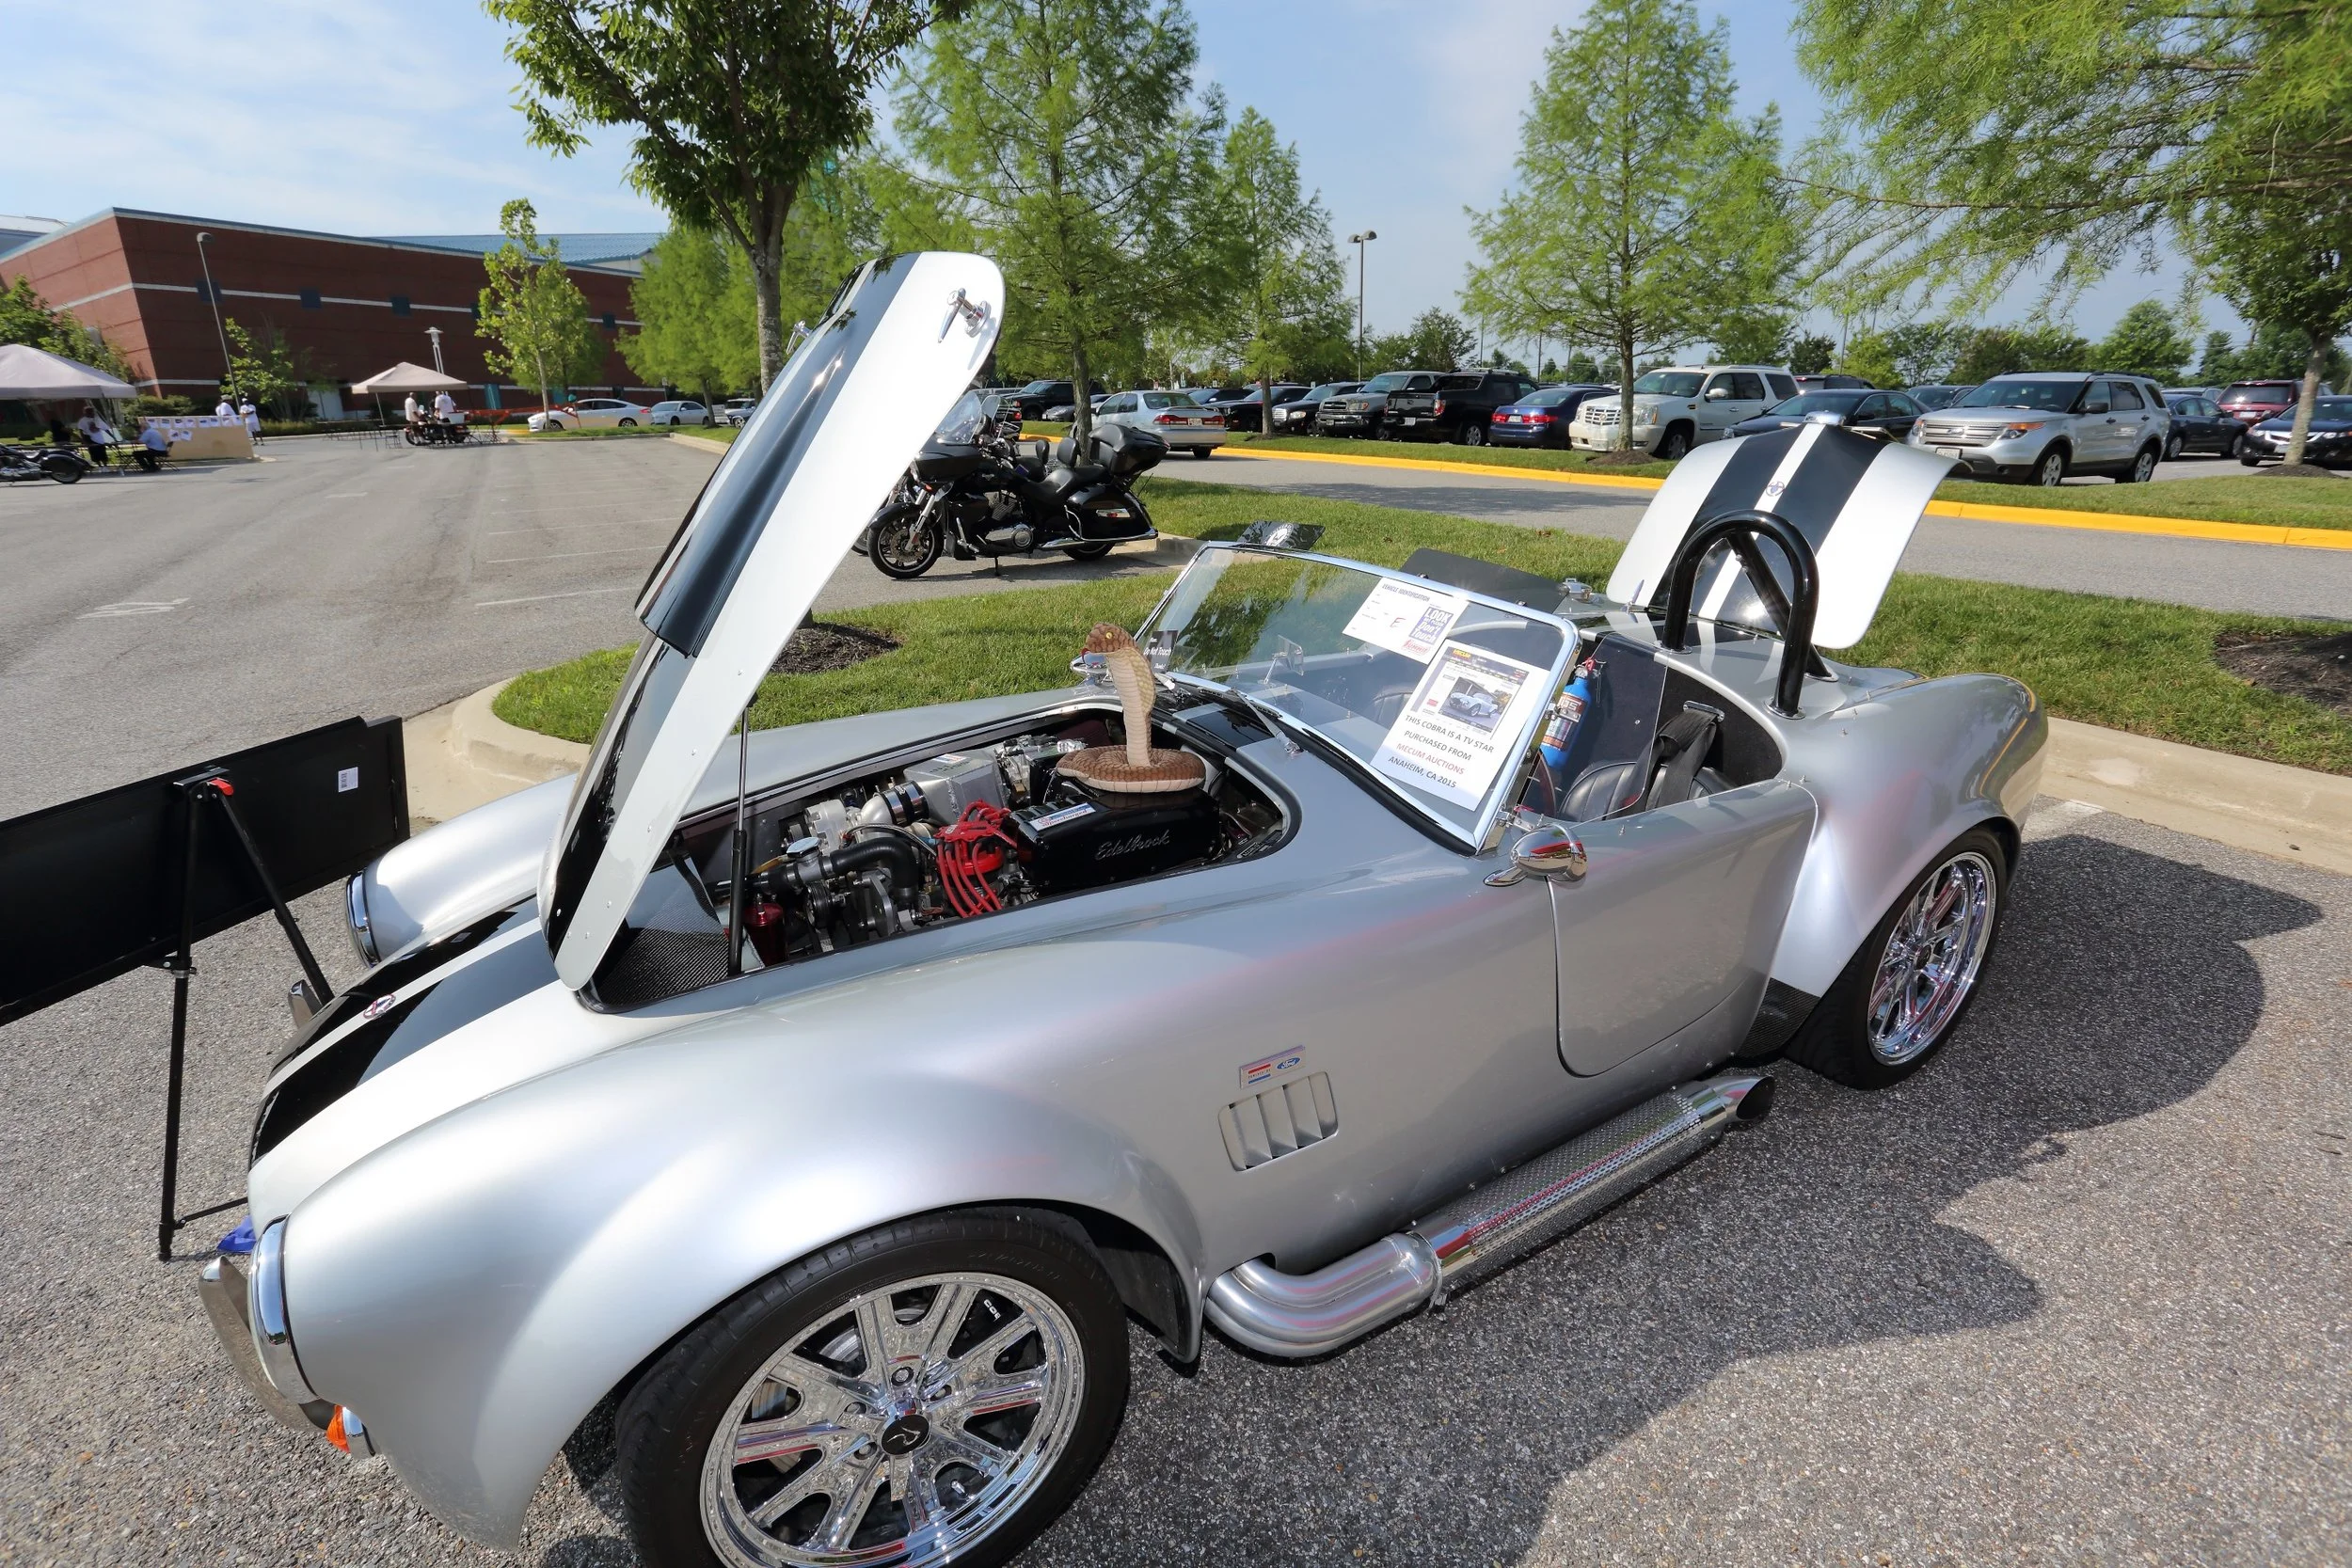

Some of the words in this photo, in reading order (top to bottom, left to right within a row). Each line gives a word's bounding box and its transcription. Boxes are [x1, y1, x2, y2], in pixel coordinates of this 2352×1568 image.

[1381, 583, 1398, 593] VEHICLE
[1398, 588, 1431, 602] IDENTIFICATION
[1424, 607, 1452, 623] LOOK
[1404, 730, 1448, 751] PURCHASED
[1448, 746, 1472, 761] FROM
[1405, 715, 1421, 725] THIS
[1421, 721, 1446, 736] COBRA
[1447, 730, 1455, 738] IS
[1463, 736, 1474, 745] TV
[1474, 740, 1495, 752] STAR
[1388, 756, 1424, 776] ANAHEIM,
[1425, 770, 1437, 781] CA
[1437, 776, 1457, 788] 2015
[1396, 743, 1426, 758] MECUM
[1426, 754, 1466, 775] AUCTIONS
[1094, 829, 1170, 862] Edelbrock
[1280, 1058, 1297, 1069] Ford
